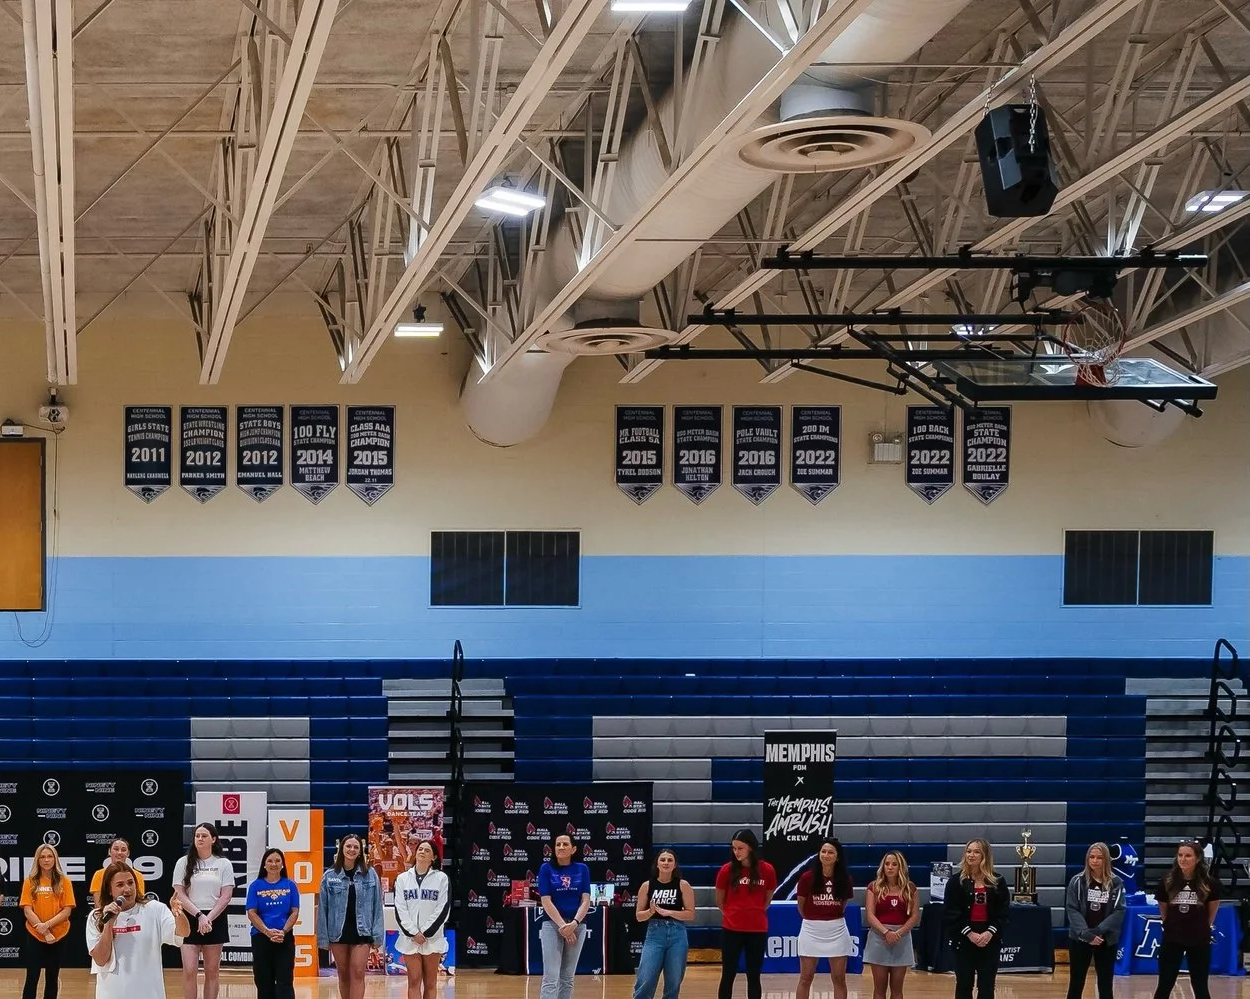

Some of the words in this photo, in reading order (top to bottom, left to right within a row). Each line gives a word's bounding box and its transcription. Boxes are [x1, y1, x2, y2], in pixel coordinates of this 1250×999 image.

[127, 423, 146, 433] GIRLS
[148, 423, 169, 433] STATE
[183, 421, 197, 430] STATE
[198, 420, 225, 431] WRESTLING
[240, 420, 262, 430] STATE
[263, 420, 281, 430] BOYS
[350, 423, 373, 432] CLASS
[375, 423, 390, 433] AAA
[802, 425, 816, 433] 200
[819, 425, 829, 433] IM
[913, 425, 926, 434] 100
[929, 425, 949, 434] BACK
[183, 429, 224, 439] CHAMPION
[294, 426, 313, 439] 100
[316, 425, 336, 439] FLY
[631, 428, 659, 437] FOOTBALL
[736, 429, 753, 438] POLE
[755, 428, 778, 437] VAULT
[974, 429, 999, 437] STATE
[350, 437, 390, 448] CHAMPION
[619, 436, 646, 444] CLASS
[649, 436, 660, 444] 5A
[810, 435, 838, 443] CHAMPIONS
[909, 435, 924, 443] STATE
[925, 434, 953, 443] CHAMPIONS
[967, 437, 1006, 447] CHAMPION
[131, 448, 165, 462] 2011
[186, 451, 221, 465] 2012
[243, 450, 278, 465] 2012
[296, 450, 333, 465] 2014
[353, 450, 388, 465] 2015
[622, 450, 656, 465] 2015
[679, 450, 716, 465] 2016
[738, 450, 775, 465] 2016
[795, 450, 835, 465] 2022
[910, 450, 950, 464] 2022
[967, 448, 1006, 462] 2022
[765, 744, 835, 762] MEMPHIS
[378, 793, 433, 810] VOLS
[777, 795, 832, 816] MEMPHIS
[764, 813, 832, 841] AMBUSH
[403, 889, 439, 901] SAINTS
[652, 889, 677, 898] MBU
